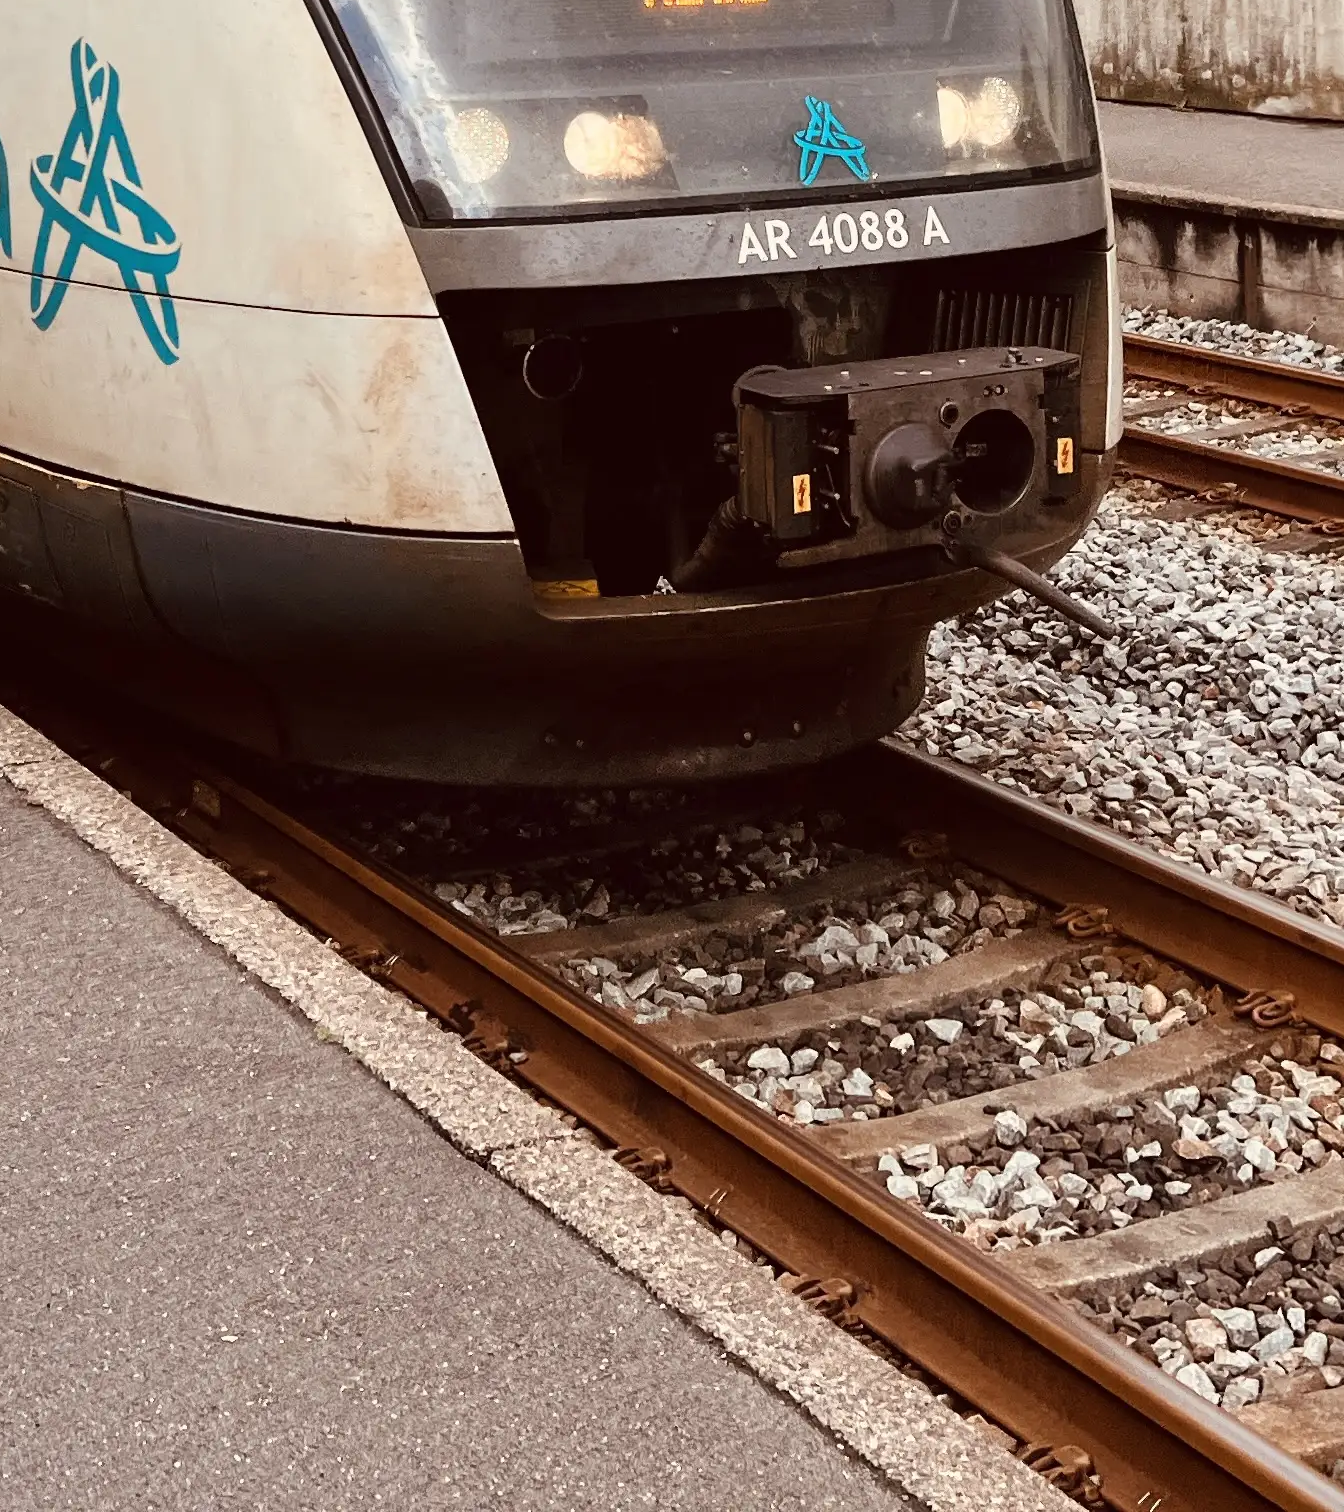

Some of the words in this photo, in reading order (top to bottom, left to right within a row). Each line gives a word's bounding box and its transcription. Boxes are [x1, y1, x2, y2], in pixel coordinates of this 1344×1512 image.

[738, 219, 798, 264] AR
[808, 208, 909, 255] 4088
[923, 205, 951, 246] A
